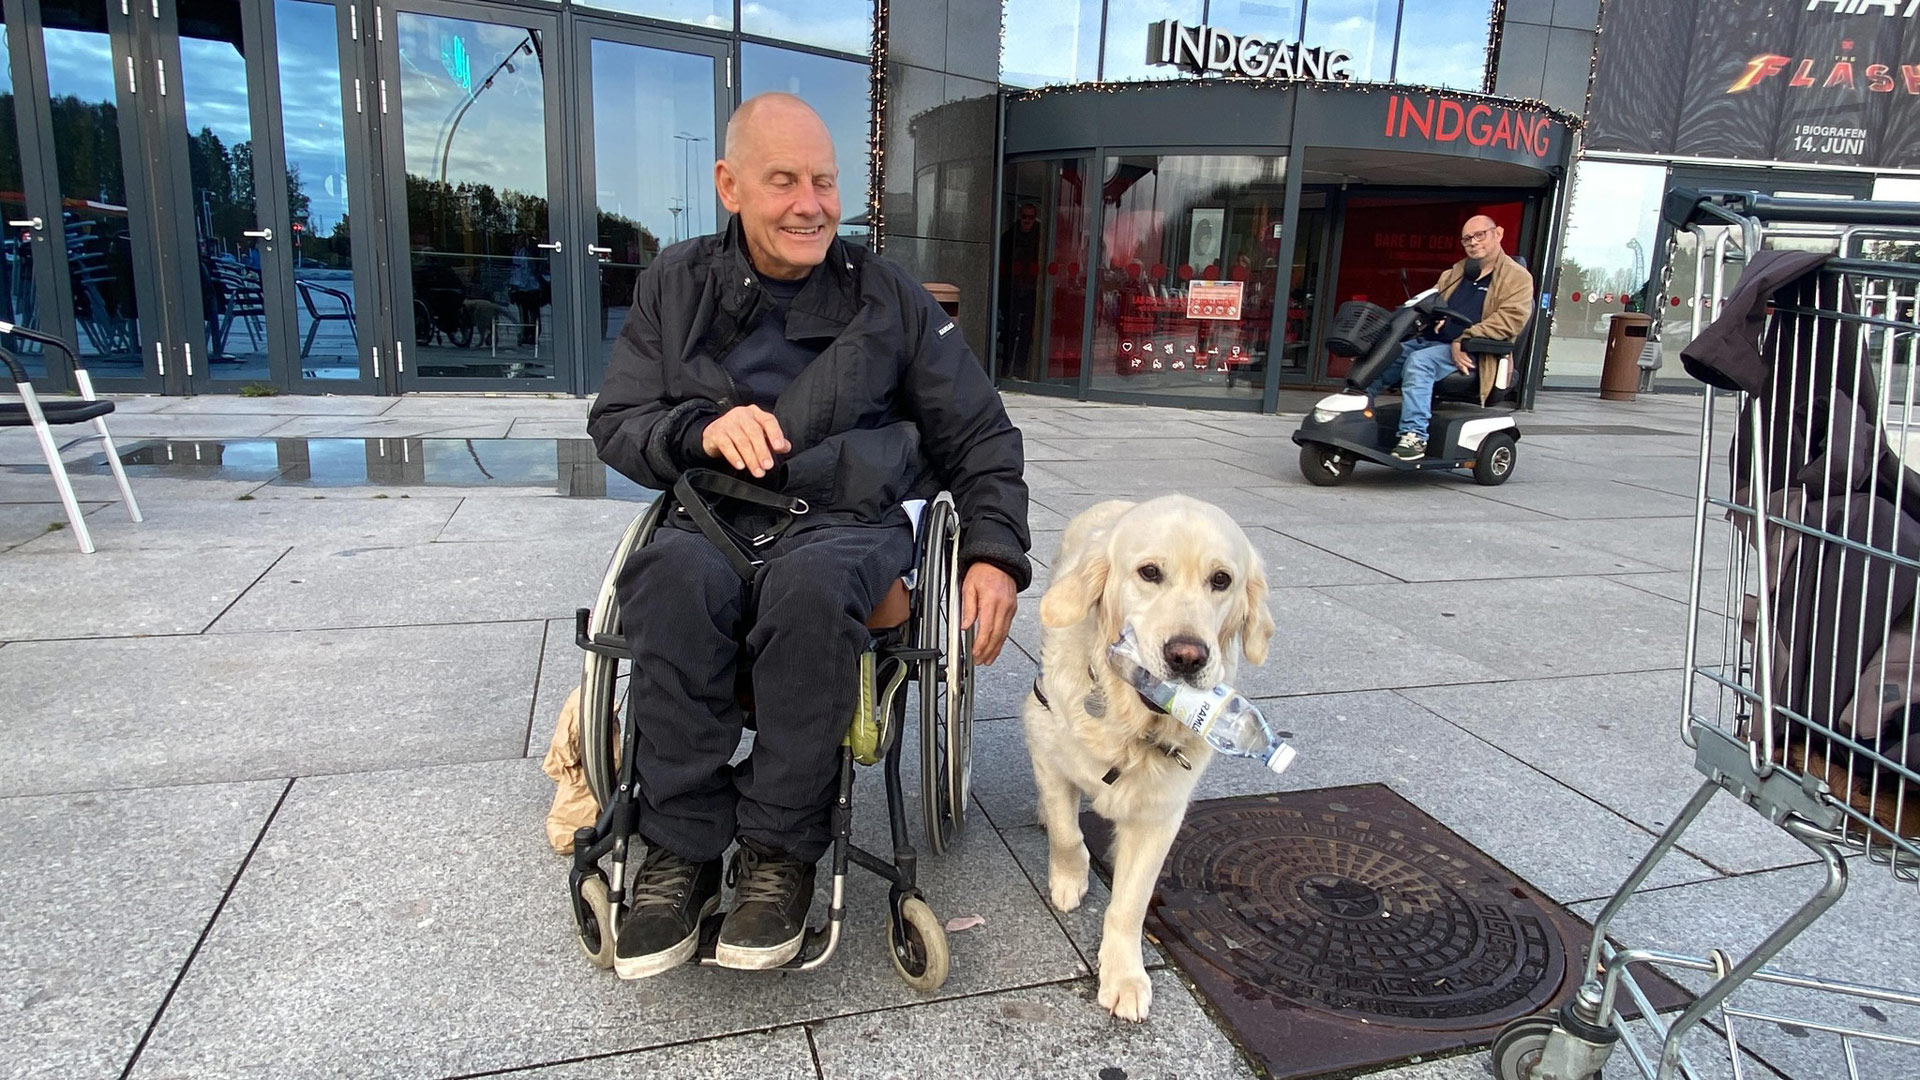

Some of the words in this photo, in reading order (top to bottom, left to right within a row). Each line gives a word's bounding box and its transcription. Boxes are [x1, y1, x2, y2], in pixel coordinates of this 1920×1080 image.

[1161, 18, 1354, 80] INDGANG
[1385, 95, 1551, 158] INDGANG
[1795, 124, 1800, 135] I
[1802, 125, 1867, 139] BIOGRAFEN
[1794, 136, 1817, 152] 14.
[1821, 138, 1865, 155] JUNI
[1375, 233, 1406, 248] BARE
